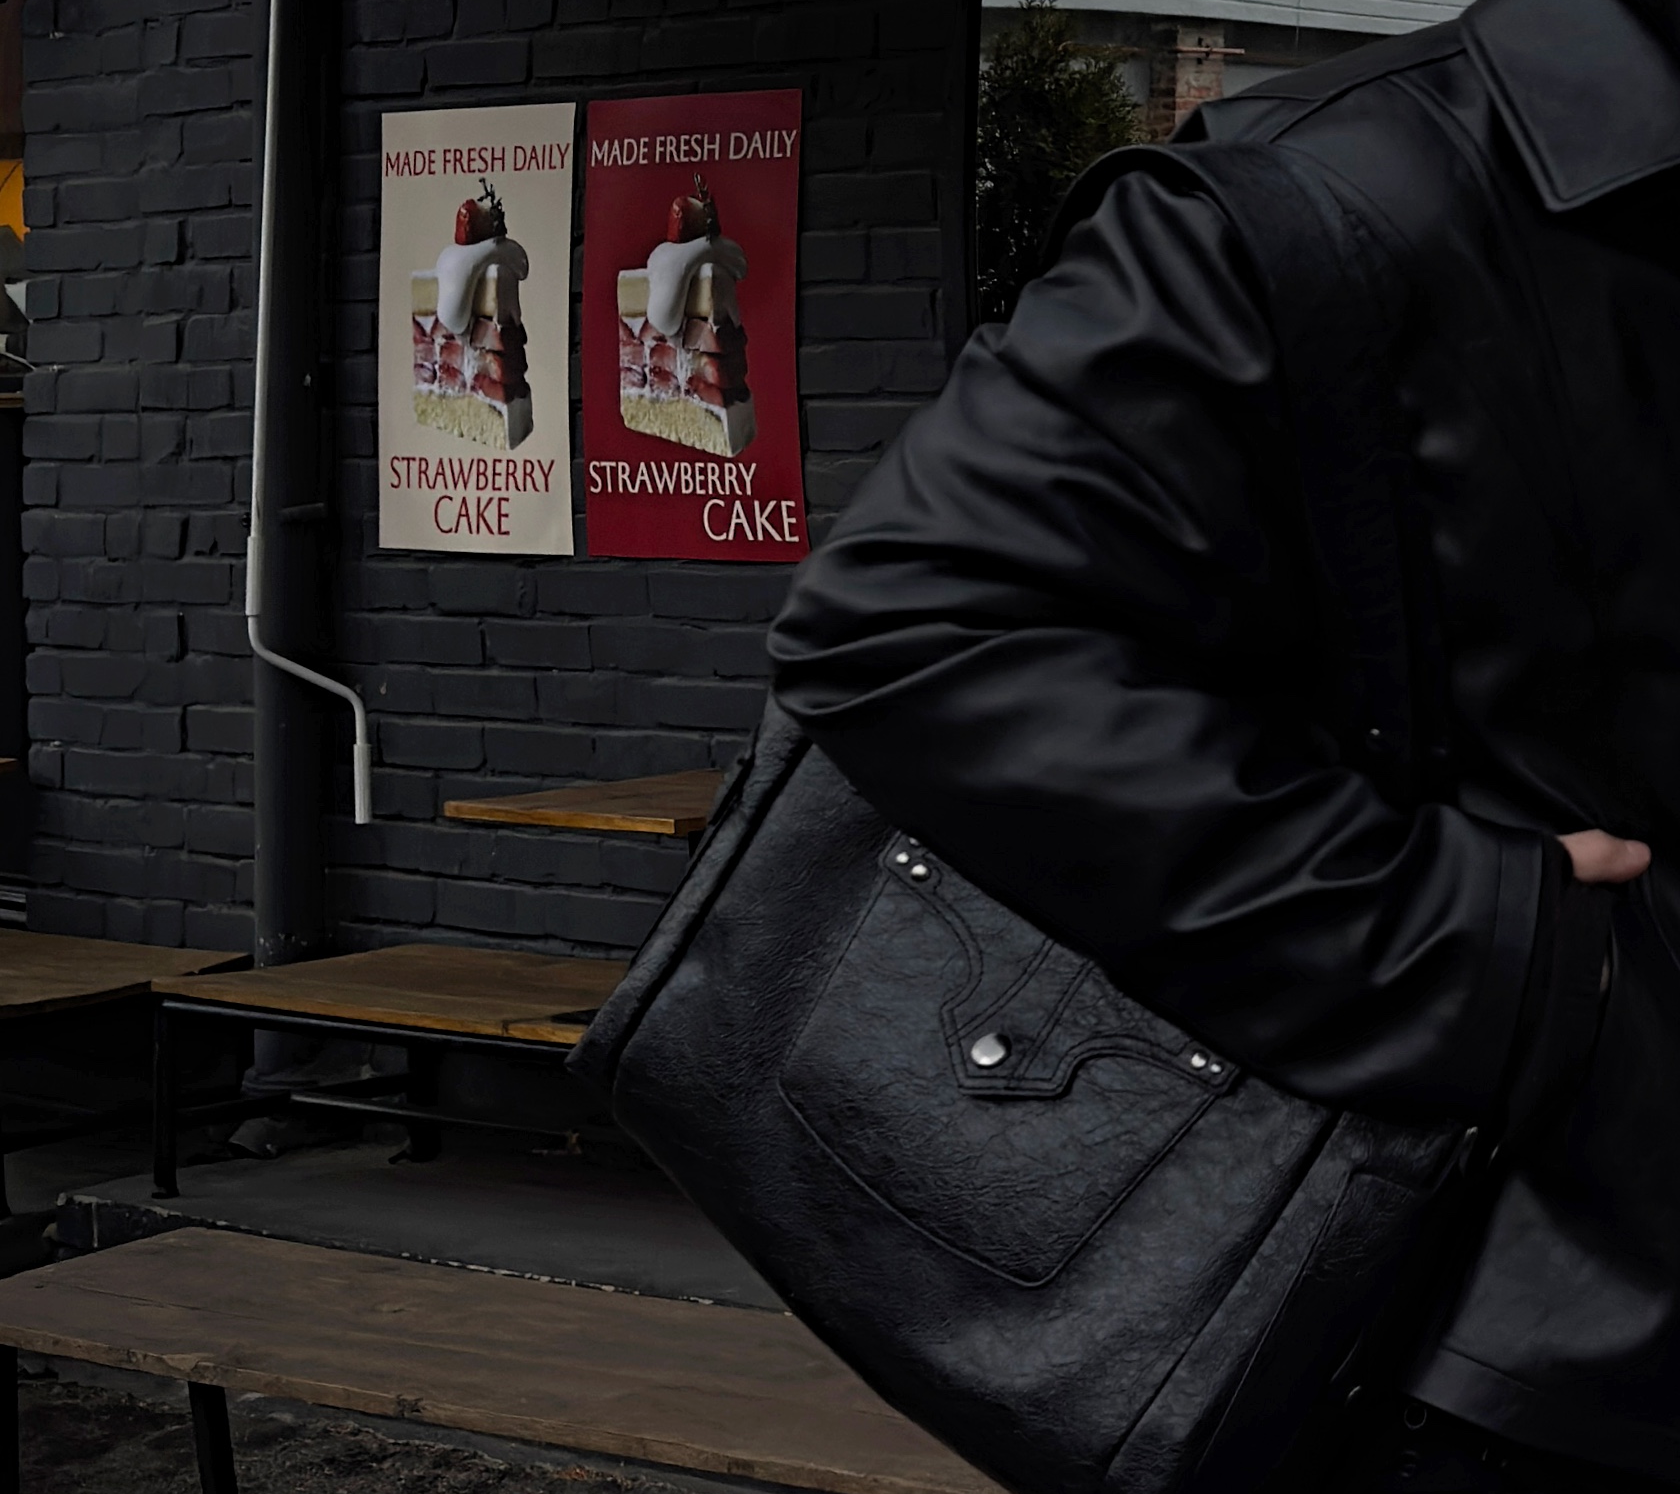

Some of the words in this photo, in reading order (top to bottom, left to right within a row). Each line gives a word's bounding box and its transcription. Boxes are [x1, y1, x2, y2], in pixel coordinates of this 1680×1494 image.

[385, 149, 436, 177] MADE
[443, 146, 506, 175] FRESH
[513, 143, 570, 172] DAILY
[591, 137, 649, 167] MADE
[655, 133, 720, 164] FRESH
[729, 129, 798, 161] DAILY
[390, 456, 555, 493] STRAWBERRY
[589, 460, 757, 497] STRAWBERRY
[434, 495, 510, 536] CAKE
[702, 499, 800, 543] CAKE
